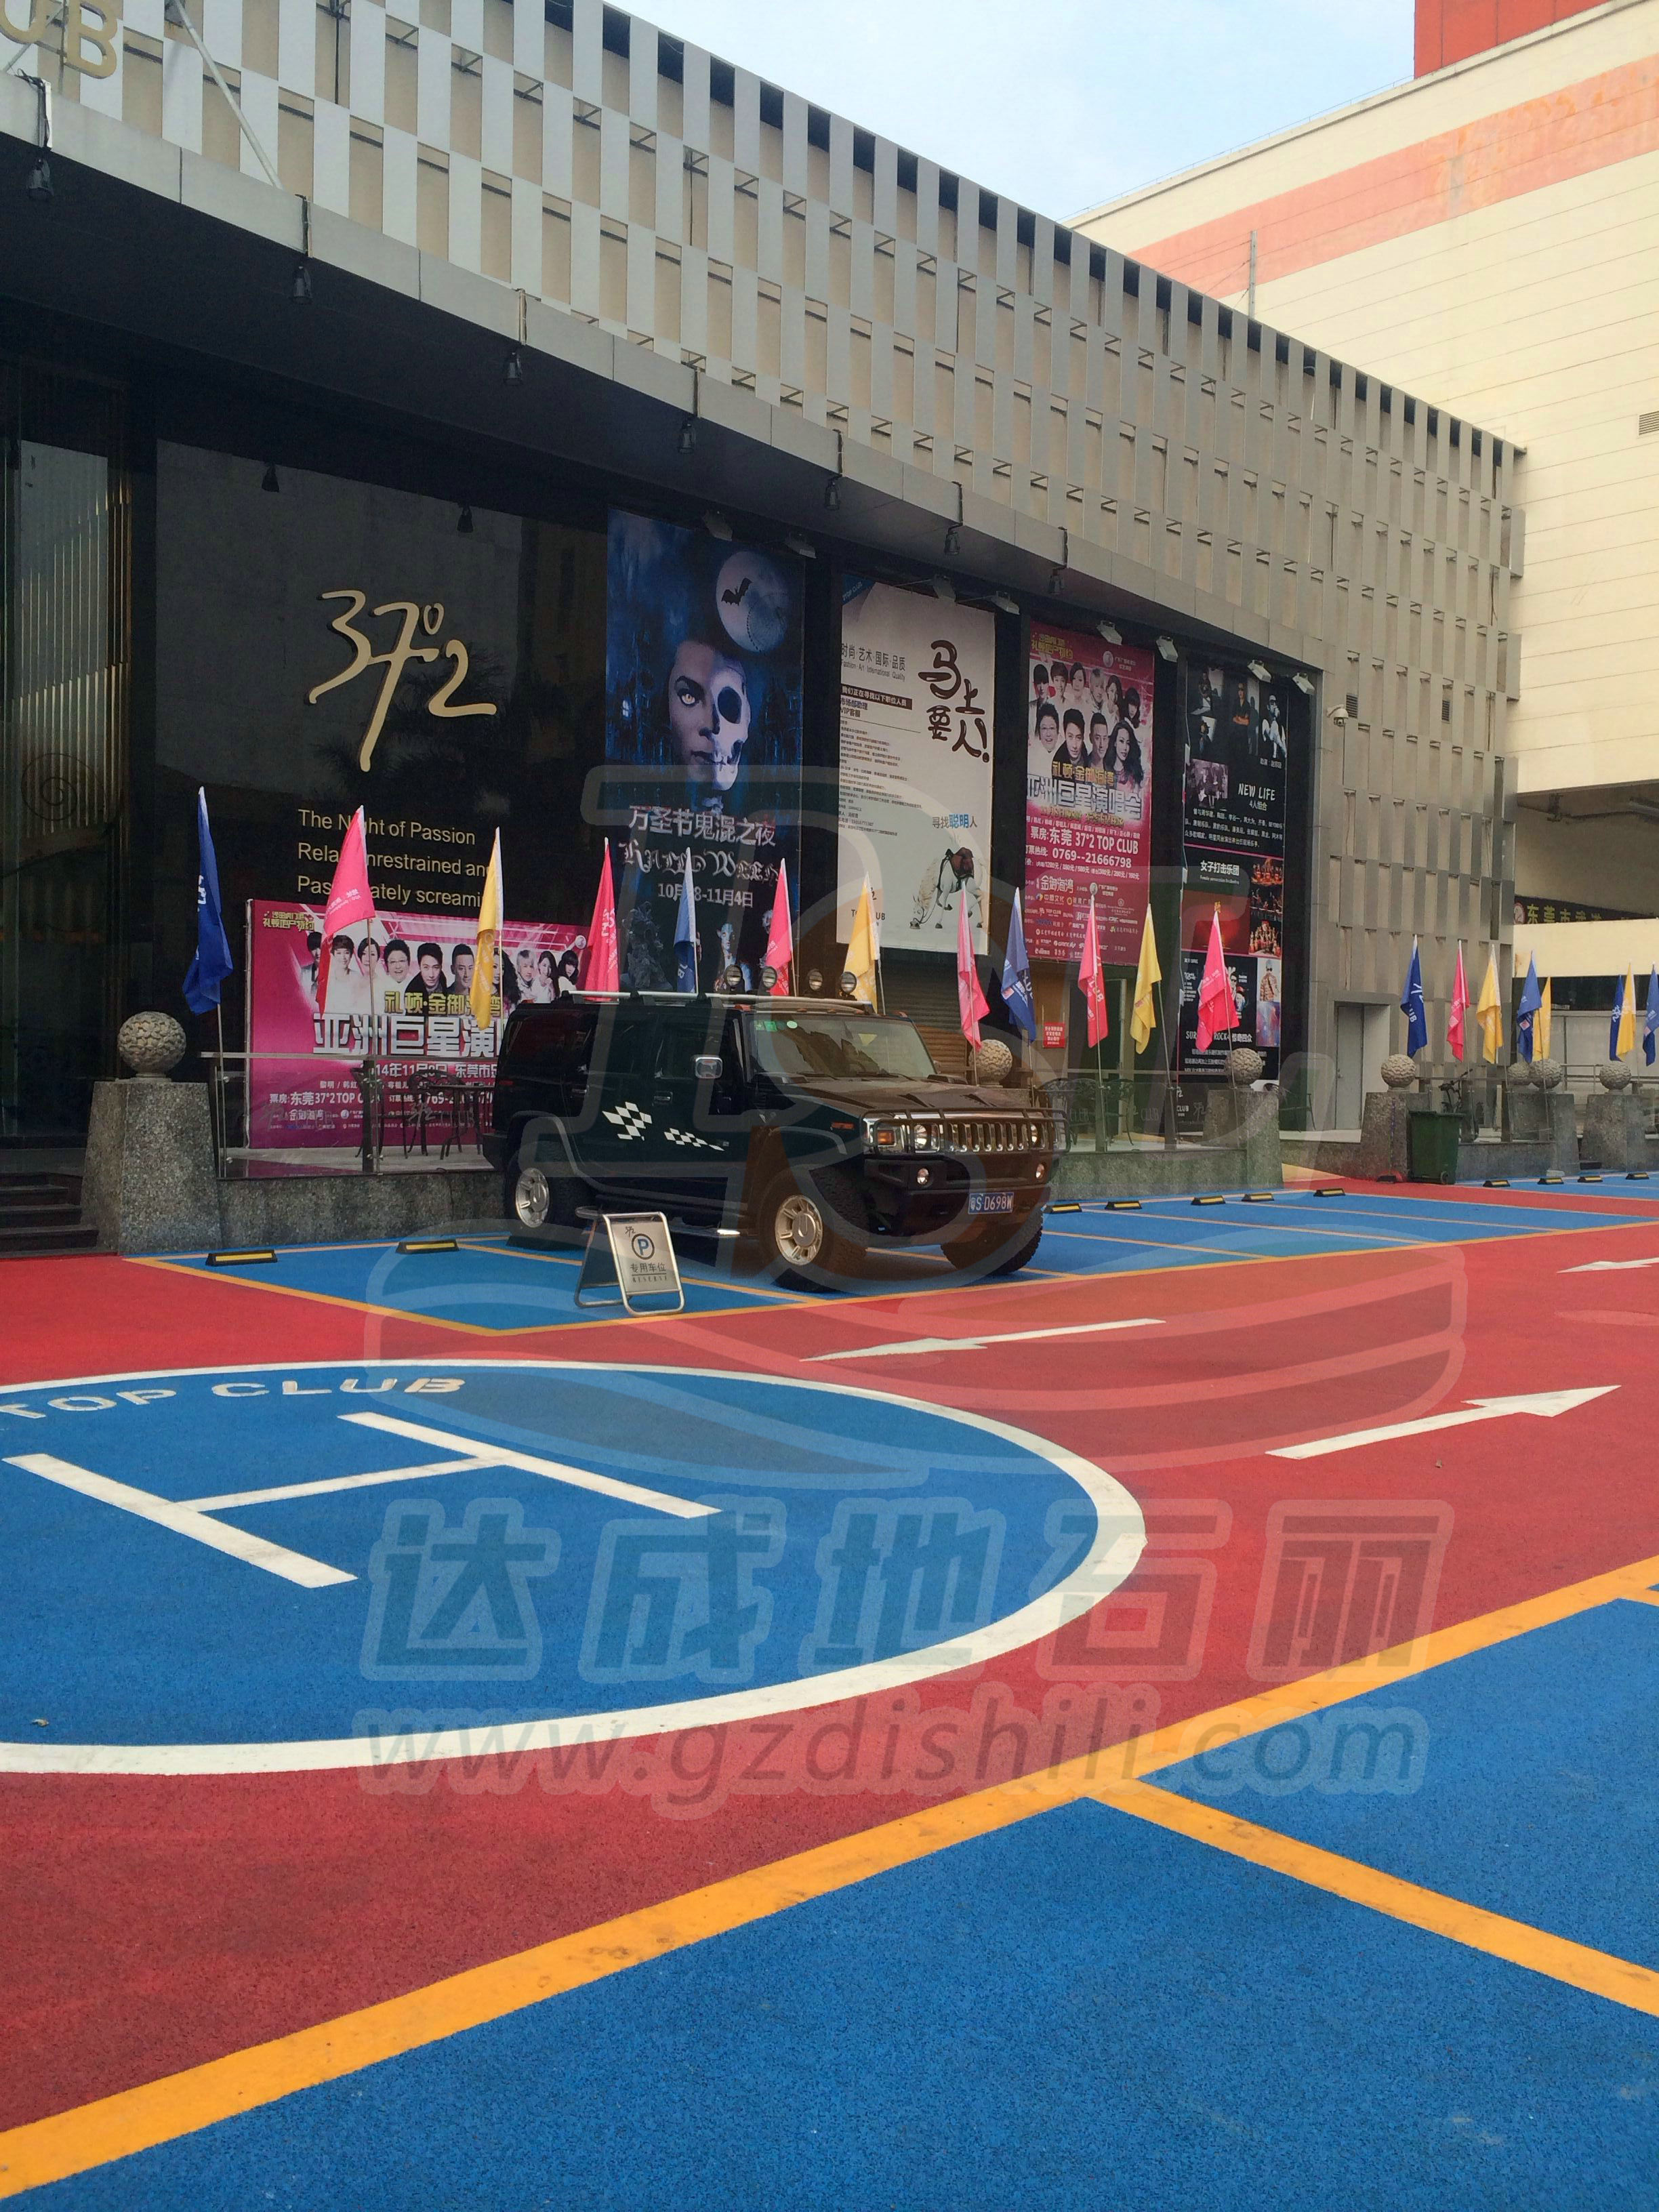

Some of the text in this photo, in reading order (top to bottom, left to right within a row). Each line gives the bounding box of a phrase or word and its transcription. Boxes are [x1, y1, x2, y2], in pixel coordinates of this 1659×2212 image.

[1237, 783, 1276, 802] NEW LIFE
[298, 808, 476, 846] The Nht of Passion
[629, 805, 776, 846] 万圣节鬼混之夜
[932, 813, 978, 830] 寻找聪明人
[1097, 834, 1115, 851] TOP
[1116, 838, 1139, 855] CLUB
[298, 842, 339, 863] Rela
[367, 854, 462, 876] nrestrained
[1200, 859, 1240, 876] 女子打击乐团
[298, 876, 411, 905] Pasately
[416, 890, 481, 907] screami
[657, 882, 754, 908] 10月8-11月4日
[313, 1013, 508, 1058] 亚洲巨星演
[336, 1092, 356, 1104] TOP
[630, 1263, 667, 1273] 专用车位
[211, 1377, 466, 1398] CLUB
